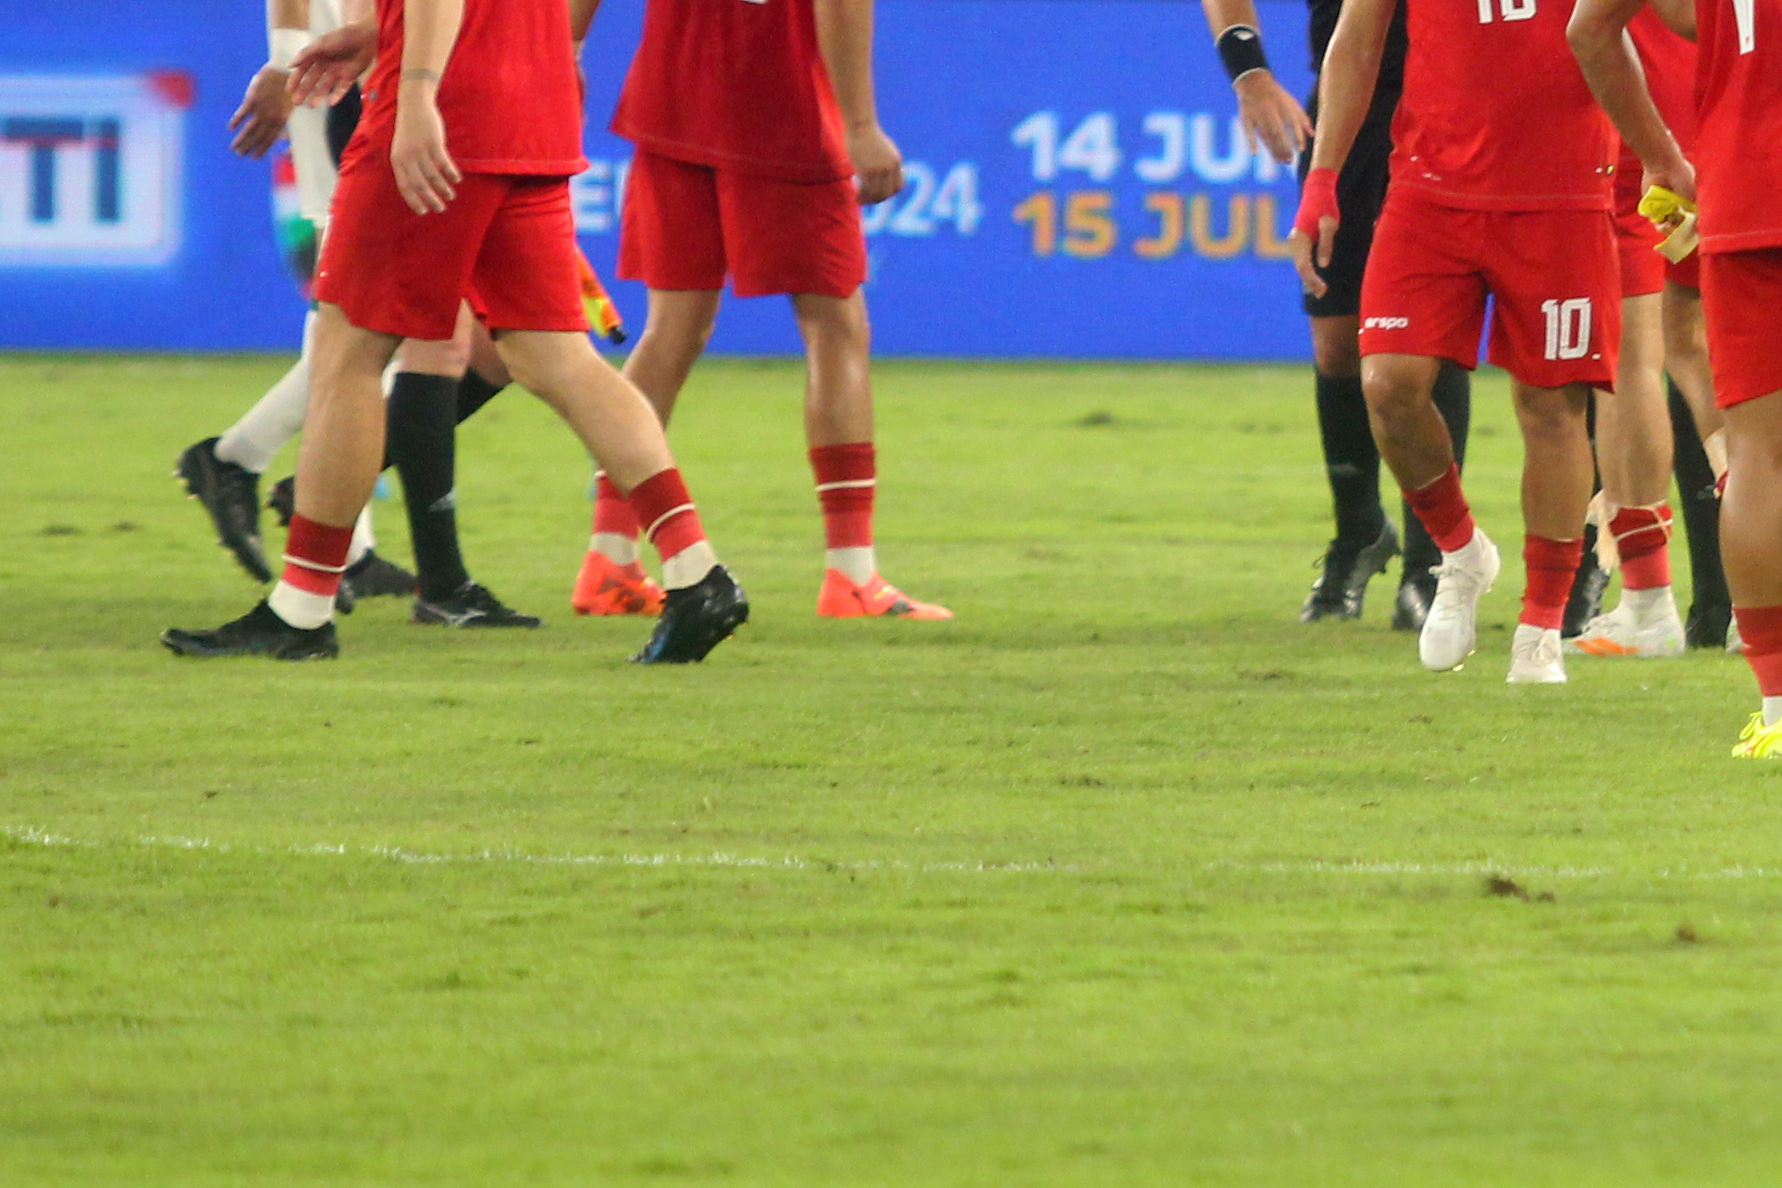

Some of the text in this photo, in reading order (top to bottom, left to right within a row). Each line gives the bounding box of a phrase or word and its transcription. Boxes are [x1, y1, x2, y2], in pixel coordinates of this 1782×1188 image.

[1010, 111, 1122, 181] 14
[1012, 192, 1118, 256] 15
[1541, 297, 1592, 360] 10
